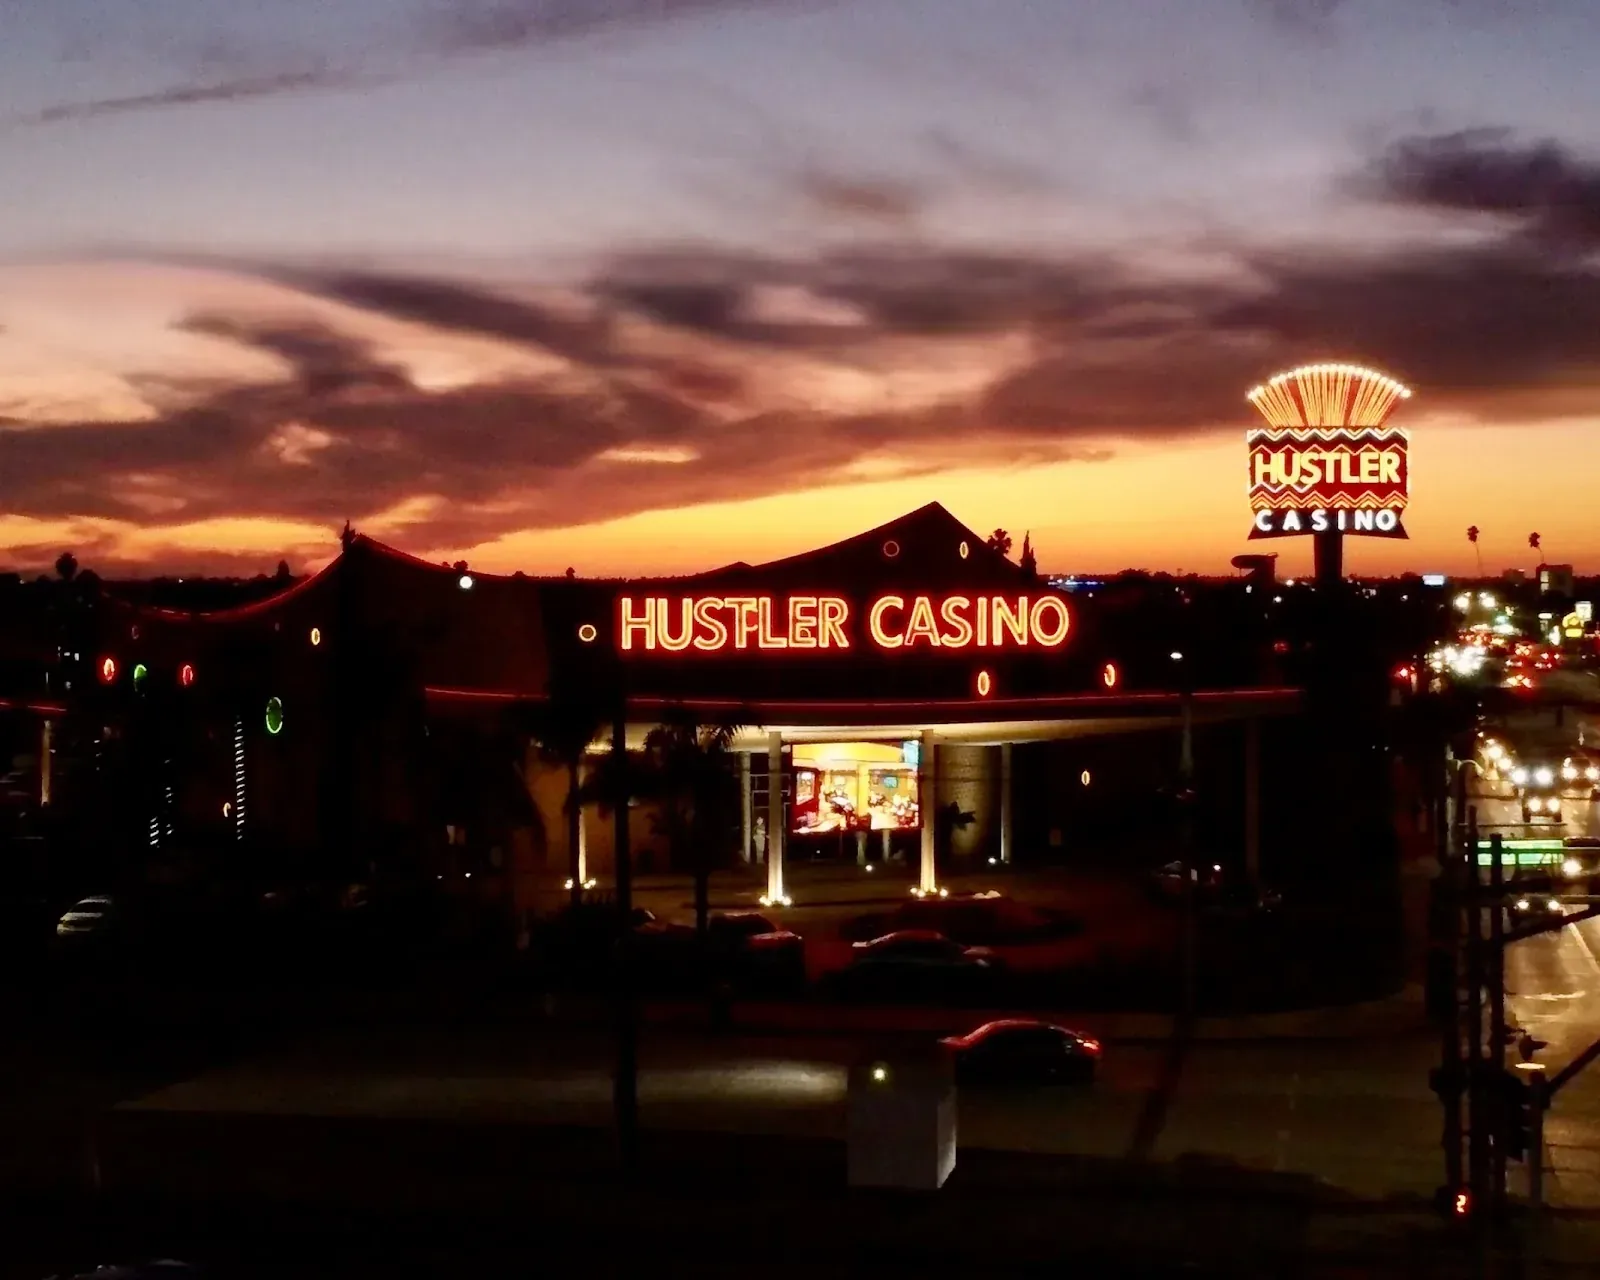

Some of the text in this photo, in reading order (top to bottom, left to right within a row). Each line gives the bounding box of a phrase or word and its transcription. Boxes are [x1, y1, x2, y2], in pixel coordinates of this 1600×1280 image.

[1255, 453, 1401, 484] HUSTLER
[1255, 509, 1397, 532] CASINO
[621, 597, 1070, 650] HUSTLER CASINO
